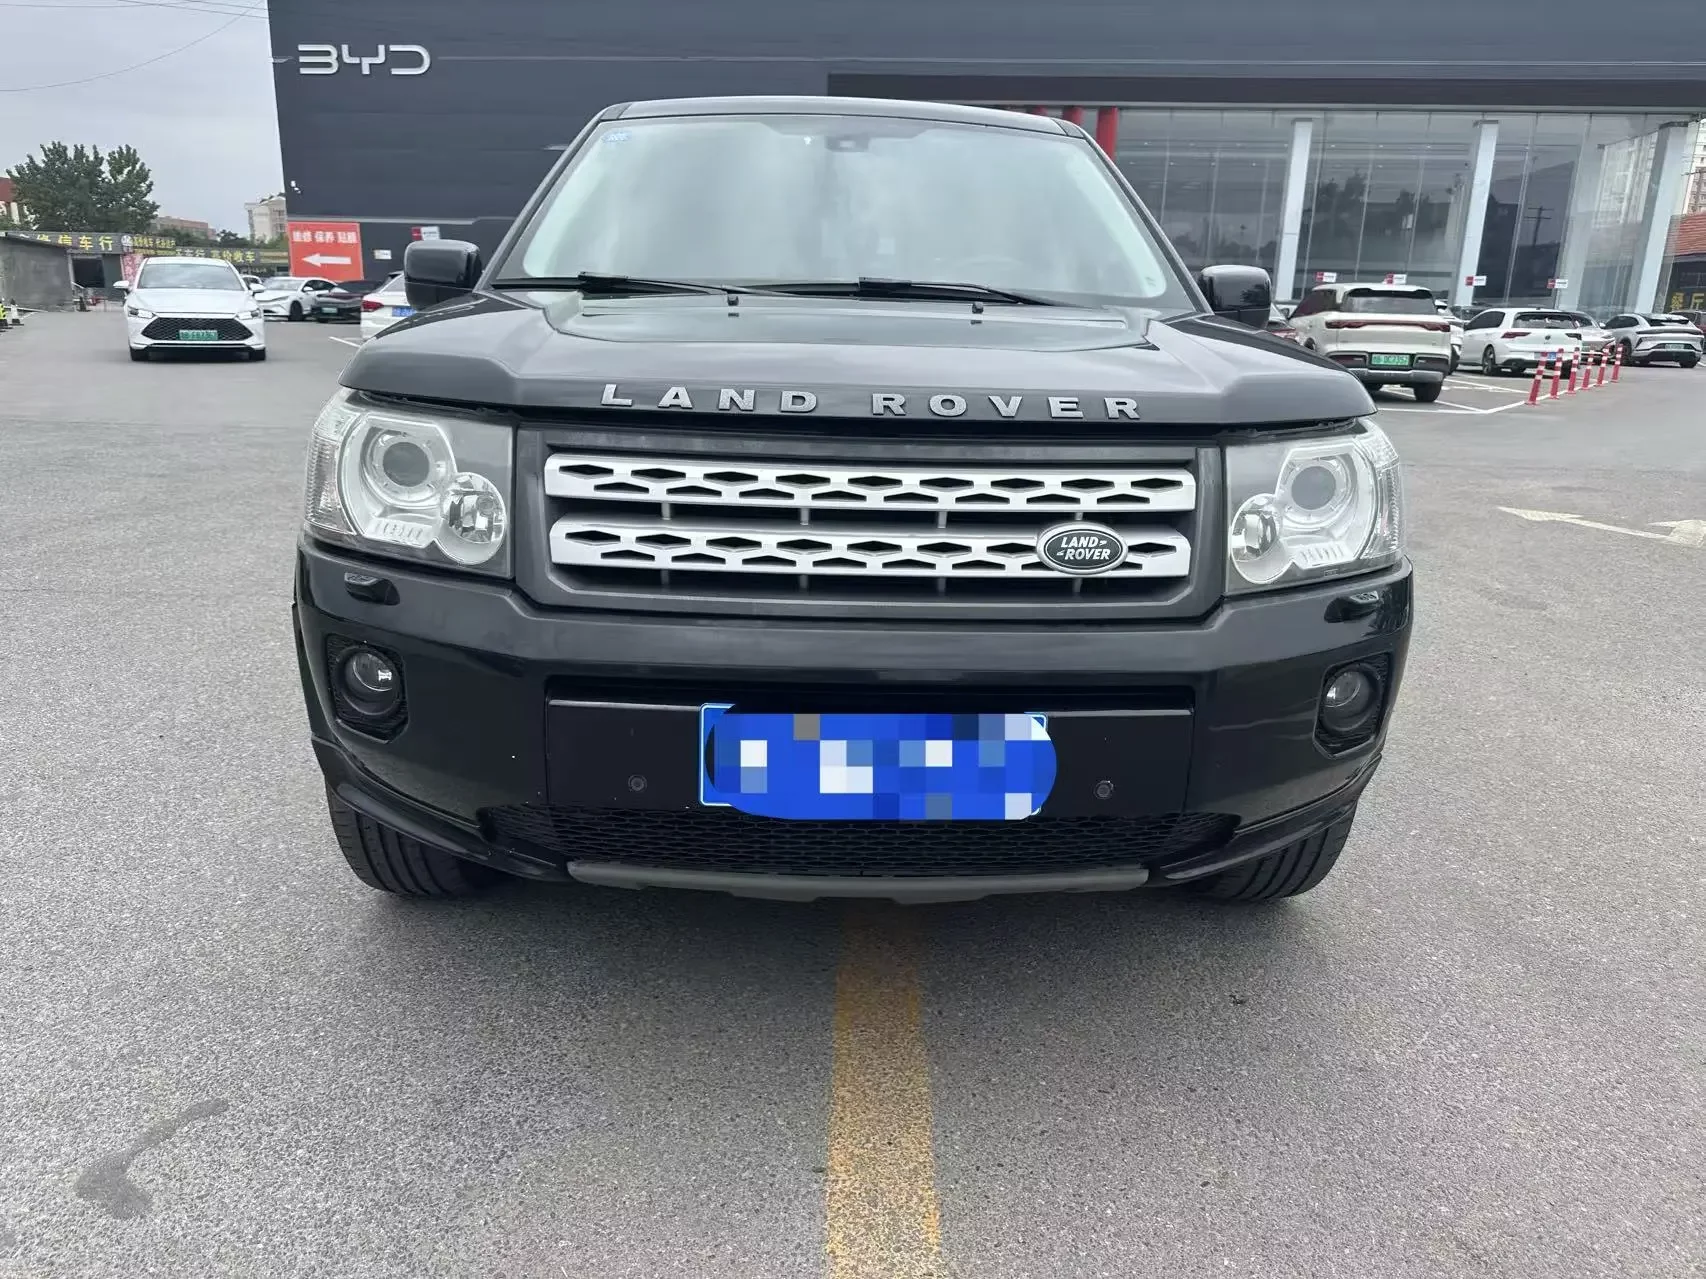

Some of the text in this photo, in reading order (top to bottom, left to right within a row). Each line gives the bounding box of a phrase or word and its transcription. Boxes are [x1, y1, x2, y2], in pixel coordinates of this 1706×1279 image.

[297, 44, 431, 75] BYD
[601, 383, 1141, 419] LAND ROVER
[1060, 536, 1099, 548] LAND
[1064, 548, 1112, 560] ROVER
